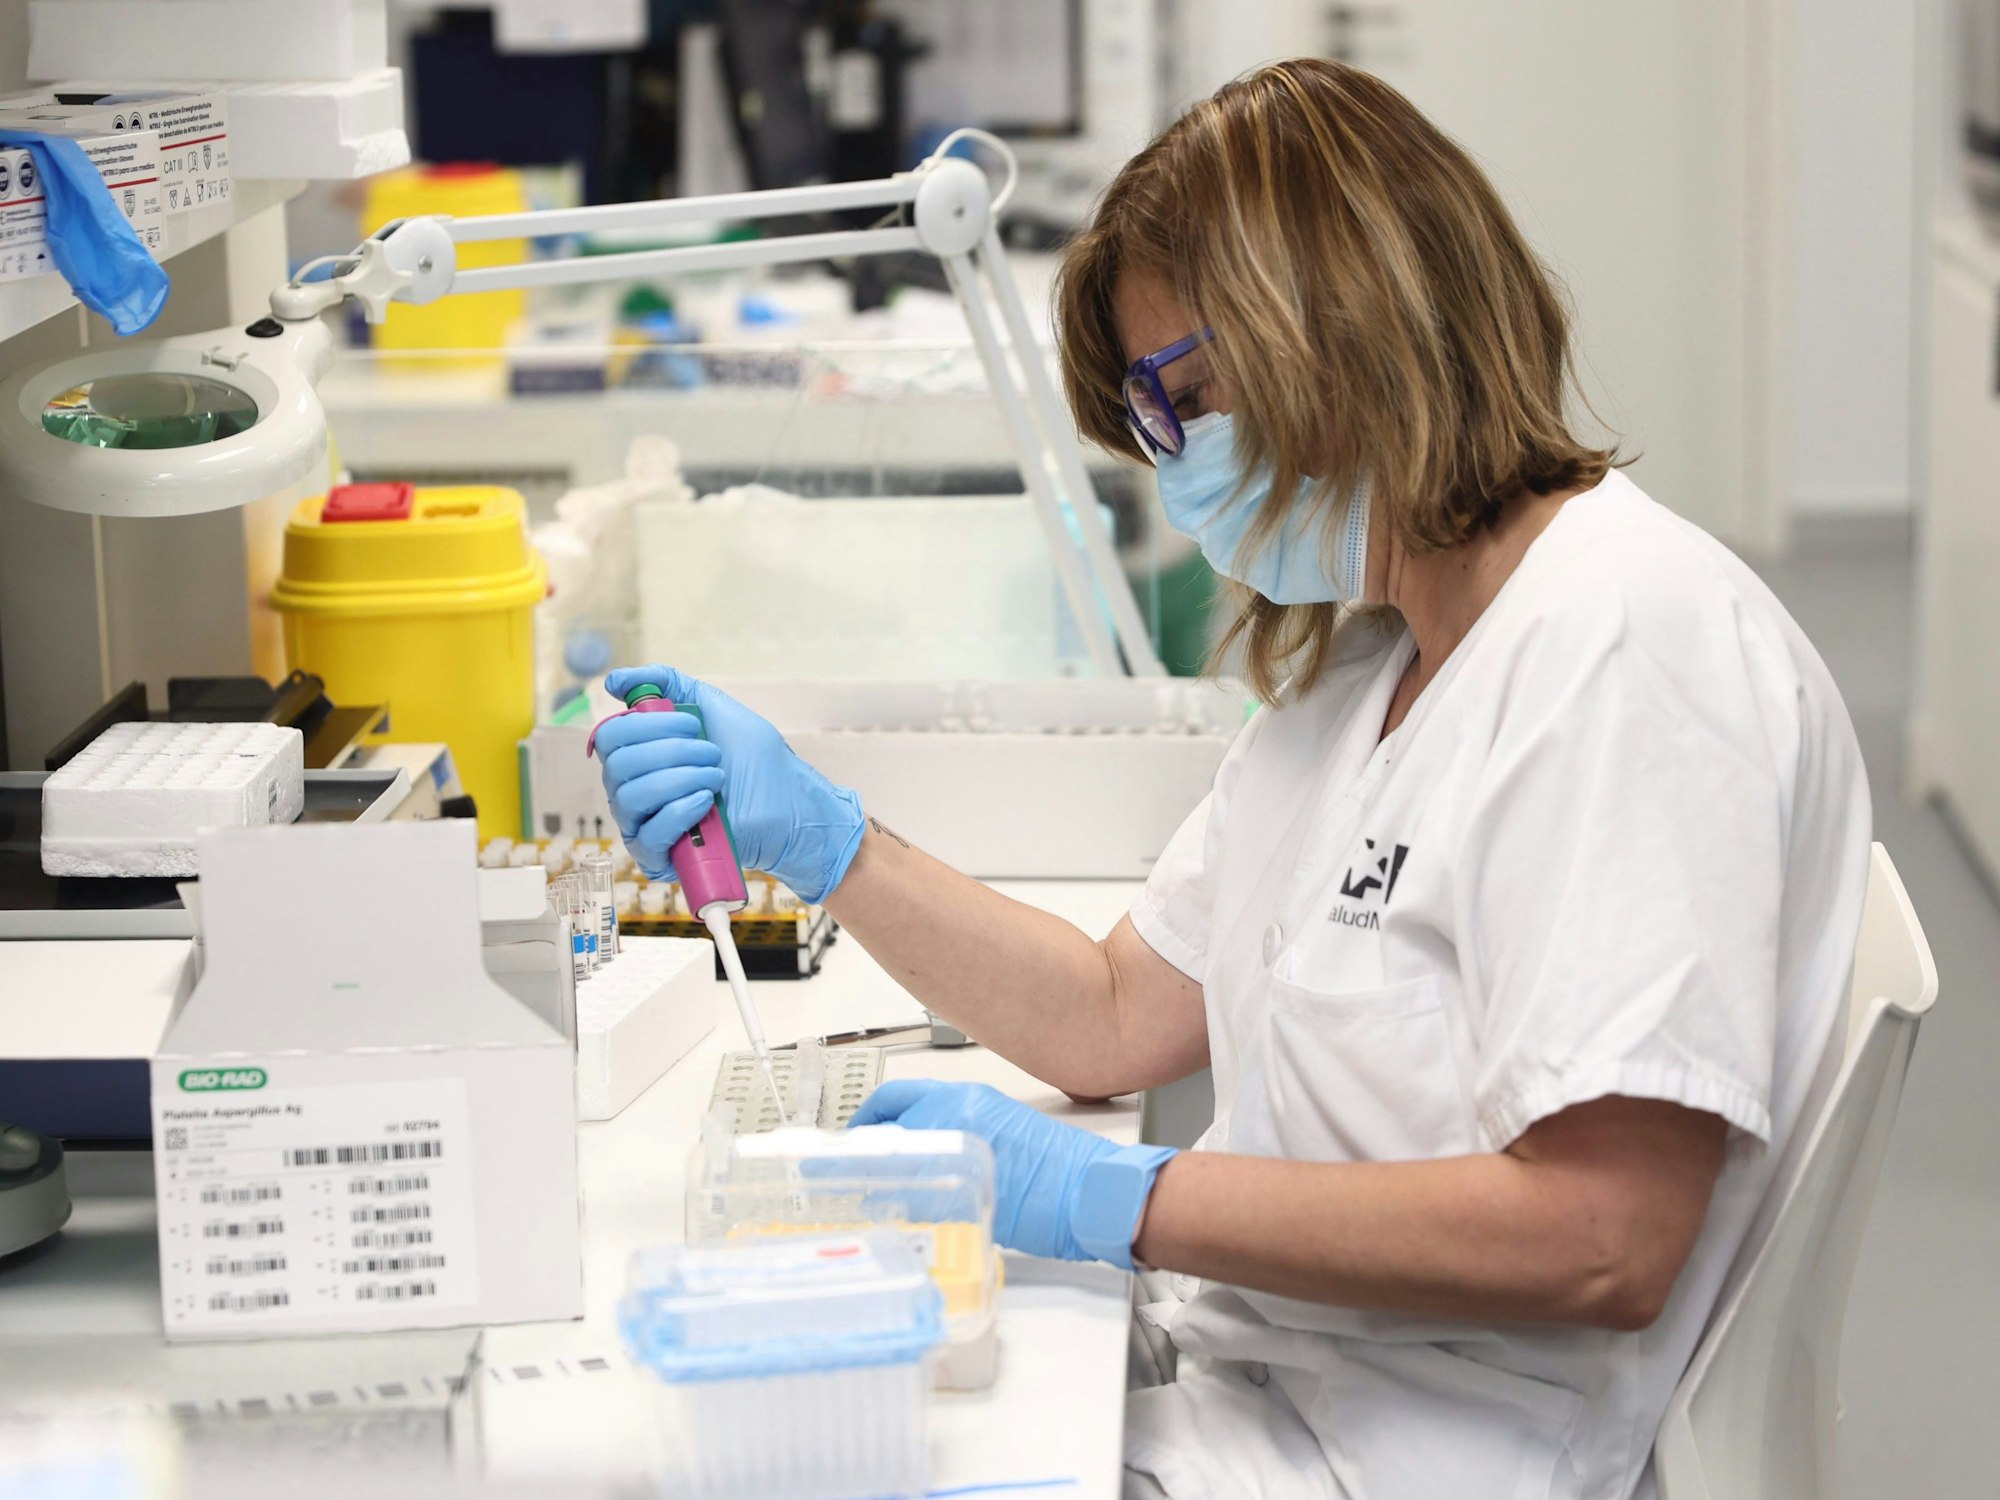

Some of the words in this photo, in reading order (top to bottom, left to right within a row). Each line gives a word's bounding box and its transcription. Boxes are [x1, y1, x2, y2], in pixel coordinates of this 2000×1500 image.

[164, 160, 176, 174] CAT
[184, 1070, 263, 1089] BIO-RAD
[212, 1105, 280, 1118] Aspergillus
